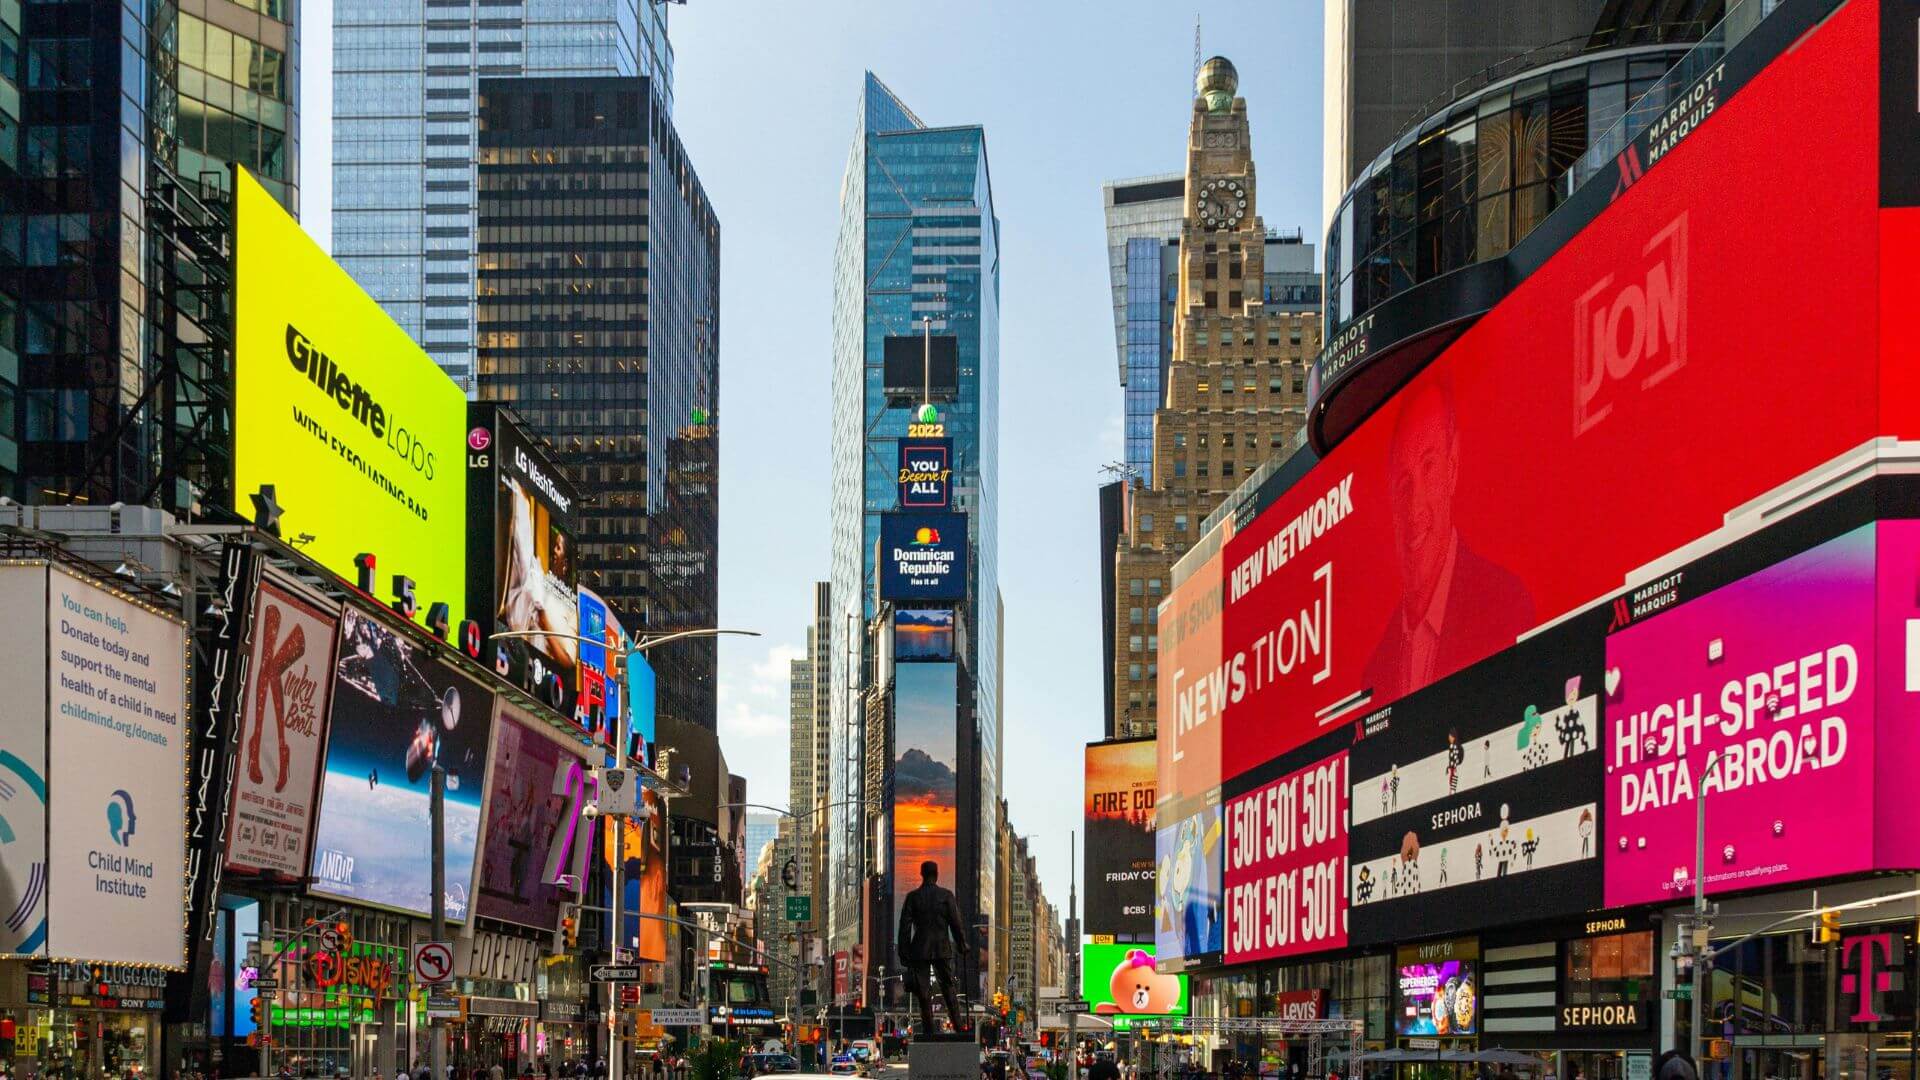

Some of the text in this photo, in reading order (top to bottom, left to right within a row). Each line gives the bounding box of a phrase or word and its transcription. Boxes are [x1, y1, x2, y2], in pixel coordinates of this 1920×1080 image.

[1649, 63, 1726, 144] MARRIOTT
[1649, 96, 1715, 166] MARQUIS
[1321, 314, 1375, 366] MARRIOTT
[1321, 339, 1366, 385] MARQUIS
[286, 323, 434, 481] Gillette Labs
[908, 423, 944, 438] 2022
[469, 454, 489, 468] LG
[900, 468, 941, 484] Deserve
[911, 461, 939, 472] YOU
[515, 446, 528, 474] LG
[528, 458, 571, 514] WashTower
[911, 482, 939, 494] ALL
[893, 548, 955, 562] Dominican
[1230, 472, 1354, 605] NEW NETWORK
[899, 561, 950, 577] Republic
[910, 578, 939, 586] Has it all
[1633, 572, 1684, 604] MARRIOTT
[1633, 590, 1677, 618] MARQUIS
[61, 592, 129, 635] You can help.
[355, 552, 480, 658] 1540
[61, 620, 150, 667] Donate today and
[61, 649, 156, 695] support the mental
[61, 672, 177, 726] health of a child in need
[1615, 644, 1859, 768] HIGH-SPEED
[60, 701, 168, 747] childmind.org/donate
[285, 702, 317, 737] Boots
[1701, 715, 1848, 797] ABROAD
[1093, 788, 1157, 813] FIRE CO
[1621, 756, 1695, 817] DATA
[1233, 796, 1262, 870] 501
[1266, 780, 1297, 859] 501
[1302, 765, 1337, 848] 501
[1431, 802, 1482, 831] SEPHORA
[88, 850, 153, 879] Child Mind
[714, 846, 722, 882] 1500
[1106, 872, 1138, 882] FRIDAY
[96, 874, 147, 899] Institute
[1129, 906, 1146, 914] CBS
[1232, 882, 1261, 953] 501
[1265, 869, 1297, 948] 501
[1301, 857, 1336, 942] 501
[1585, 918, 1626, 933] SEPHORA
[469, 930, 540, 983] FOREVER
[1419, 942, 1454, 959] INVICTA
[103, 964, 168, 988] LUGGAGE
[598, 969, 634, 978] ONE WAY
[1841, 933, 1892, 1022] T
[121, 998, 145, 1009] SONY
[1563, 1004, 1637, 1027] SEPHORA
